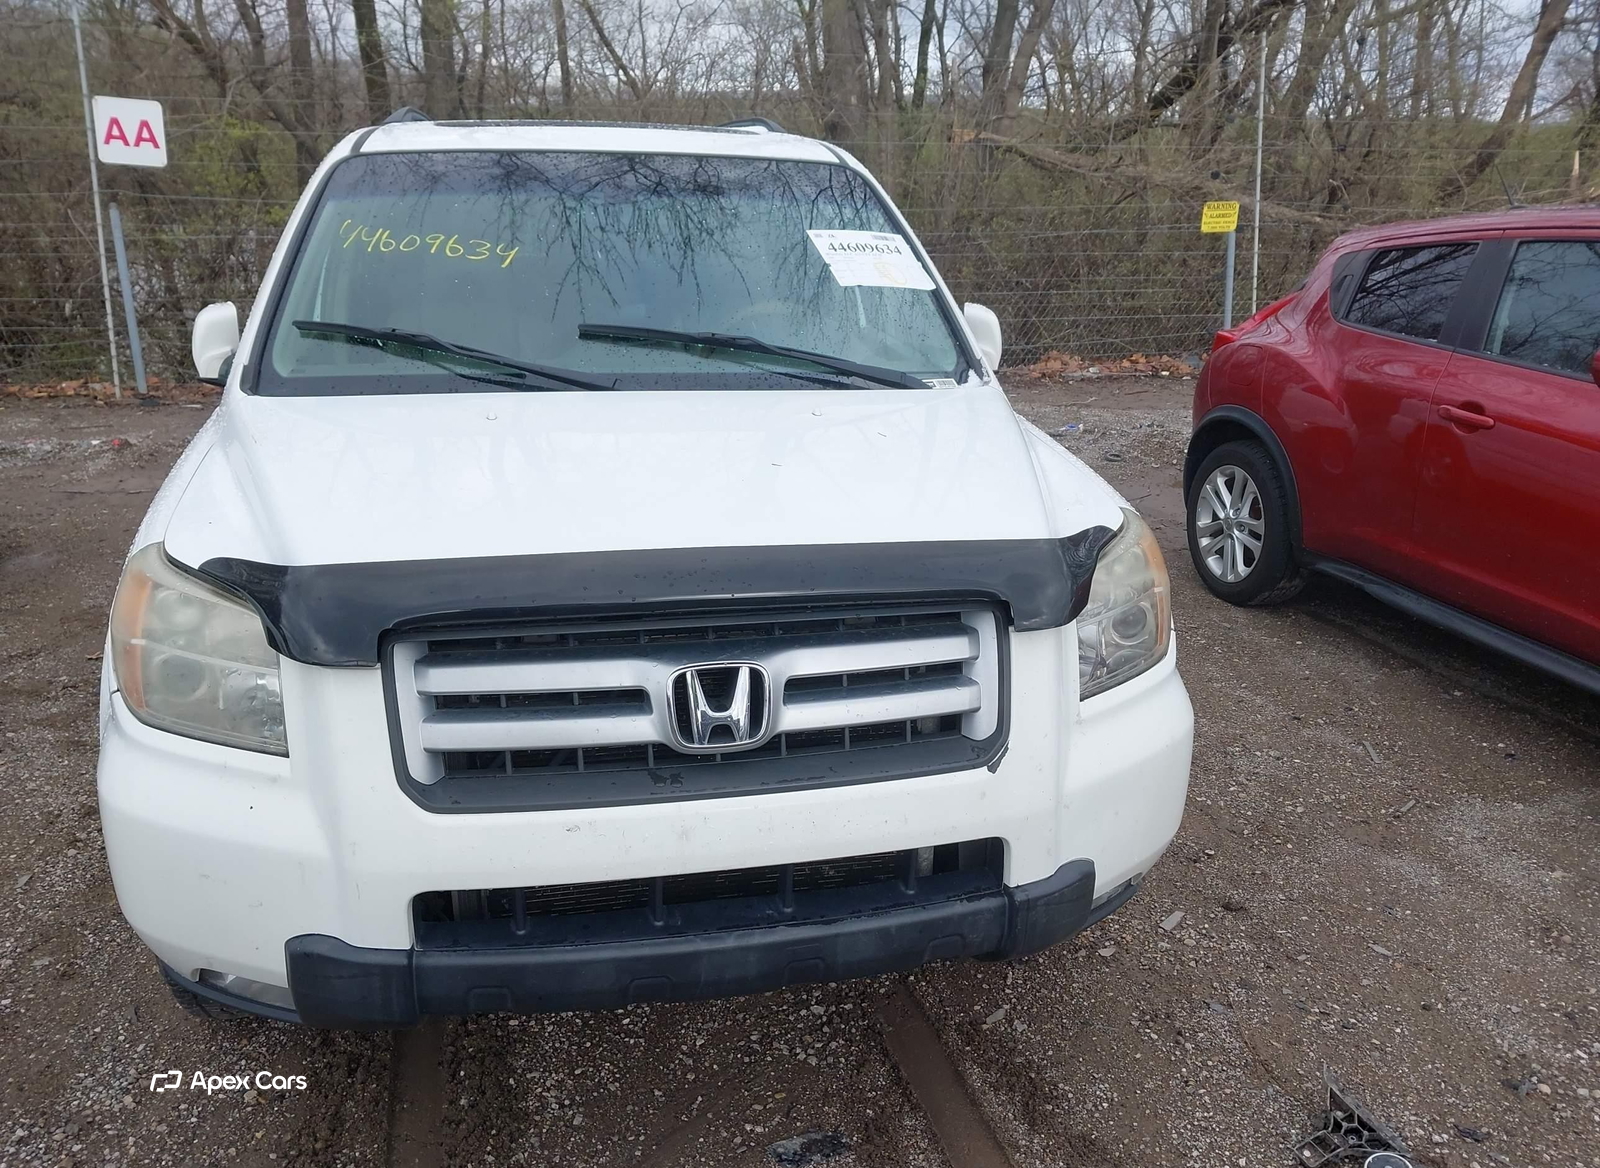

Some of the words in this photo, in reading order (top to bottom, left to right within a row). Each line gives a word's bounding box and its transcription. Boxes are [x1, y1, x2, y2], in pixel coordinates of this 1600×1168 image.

[104, 116, 160, 149] AA
[1206, 202, 1237, 210] WARNING
[339, 219, 520, 268] 44609634
[828, 242, 902, 255] 44609634
